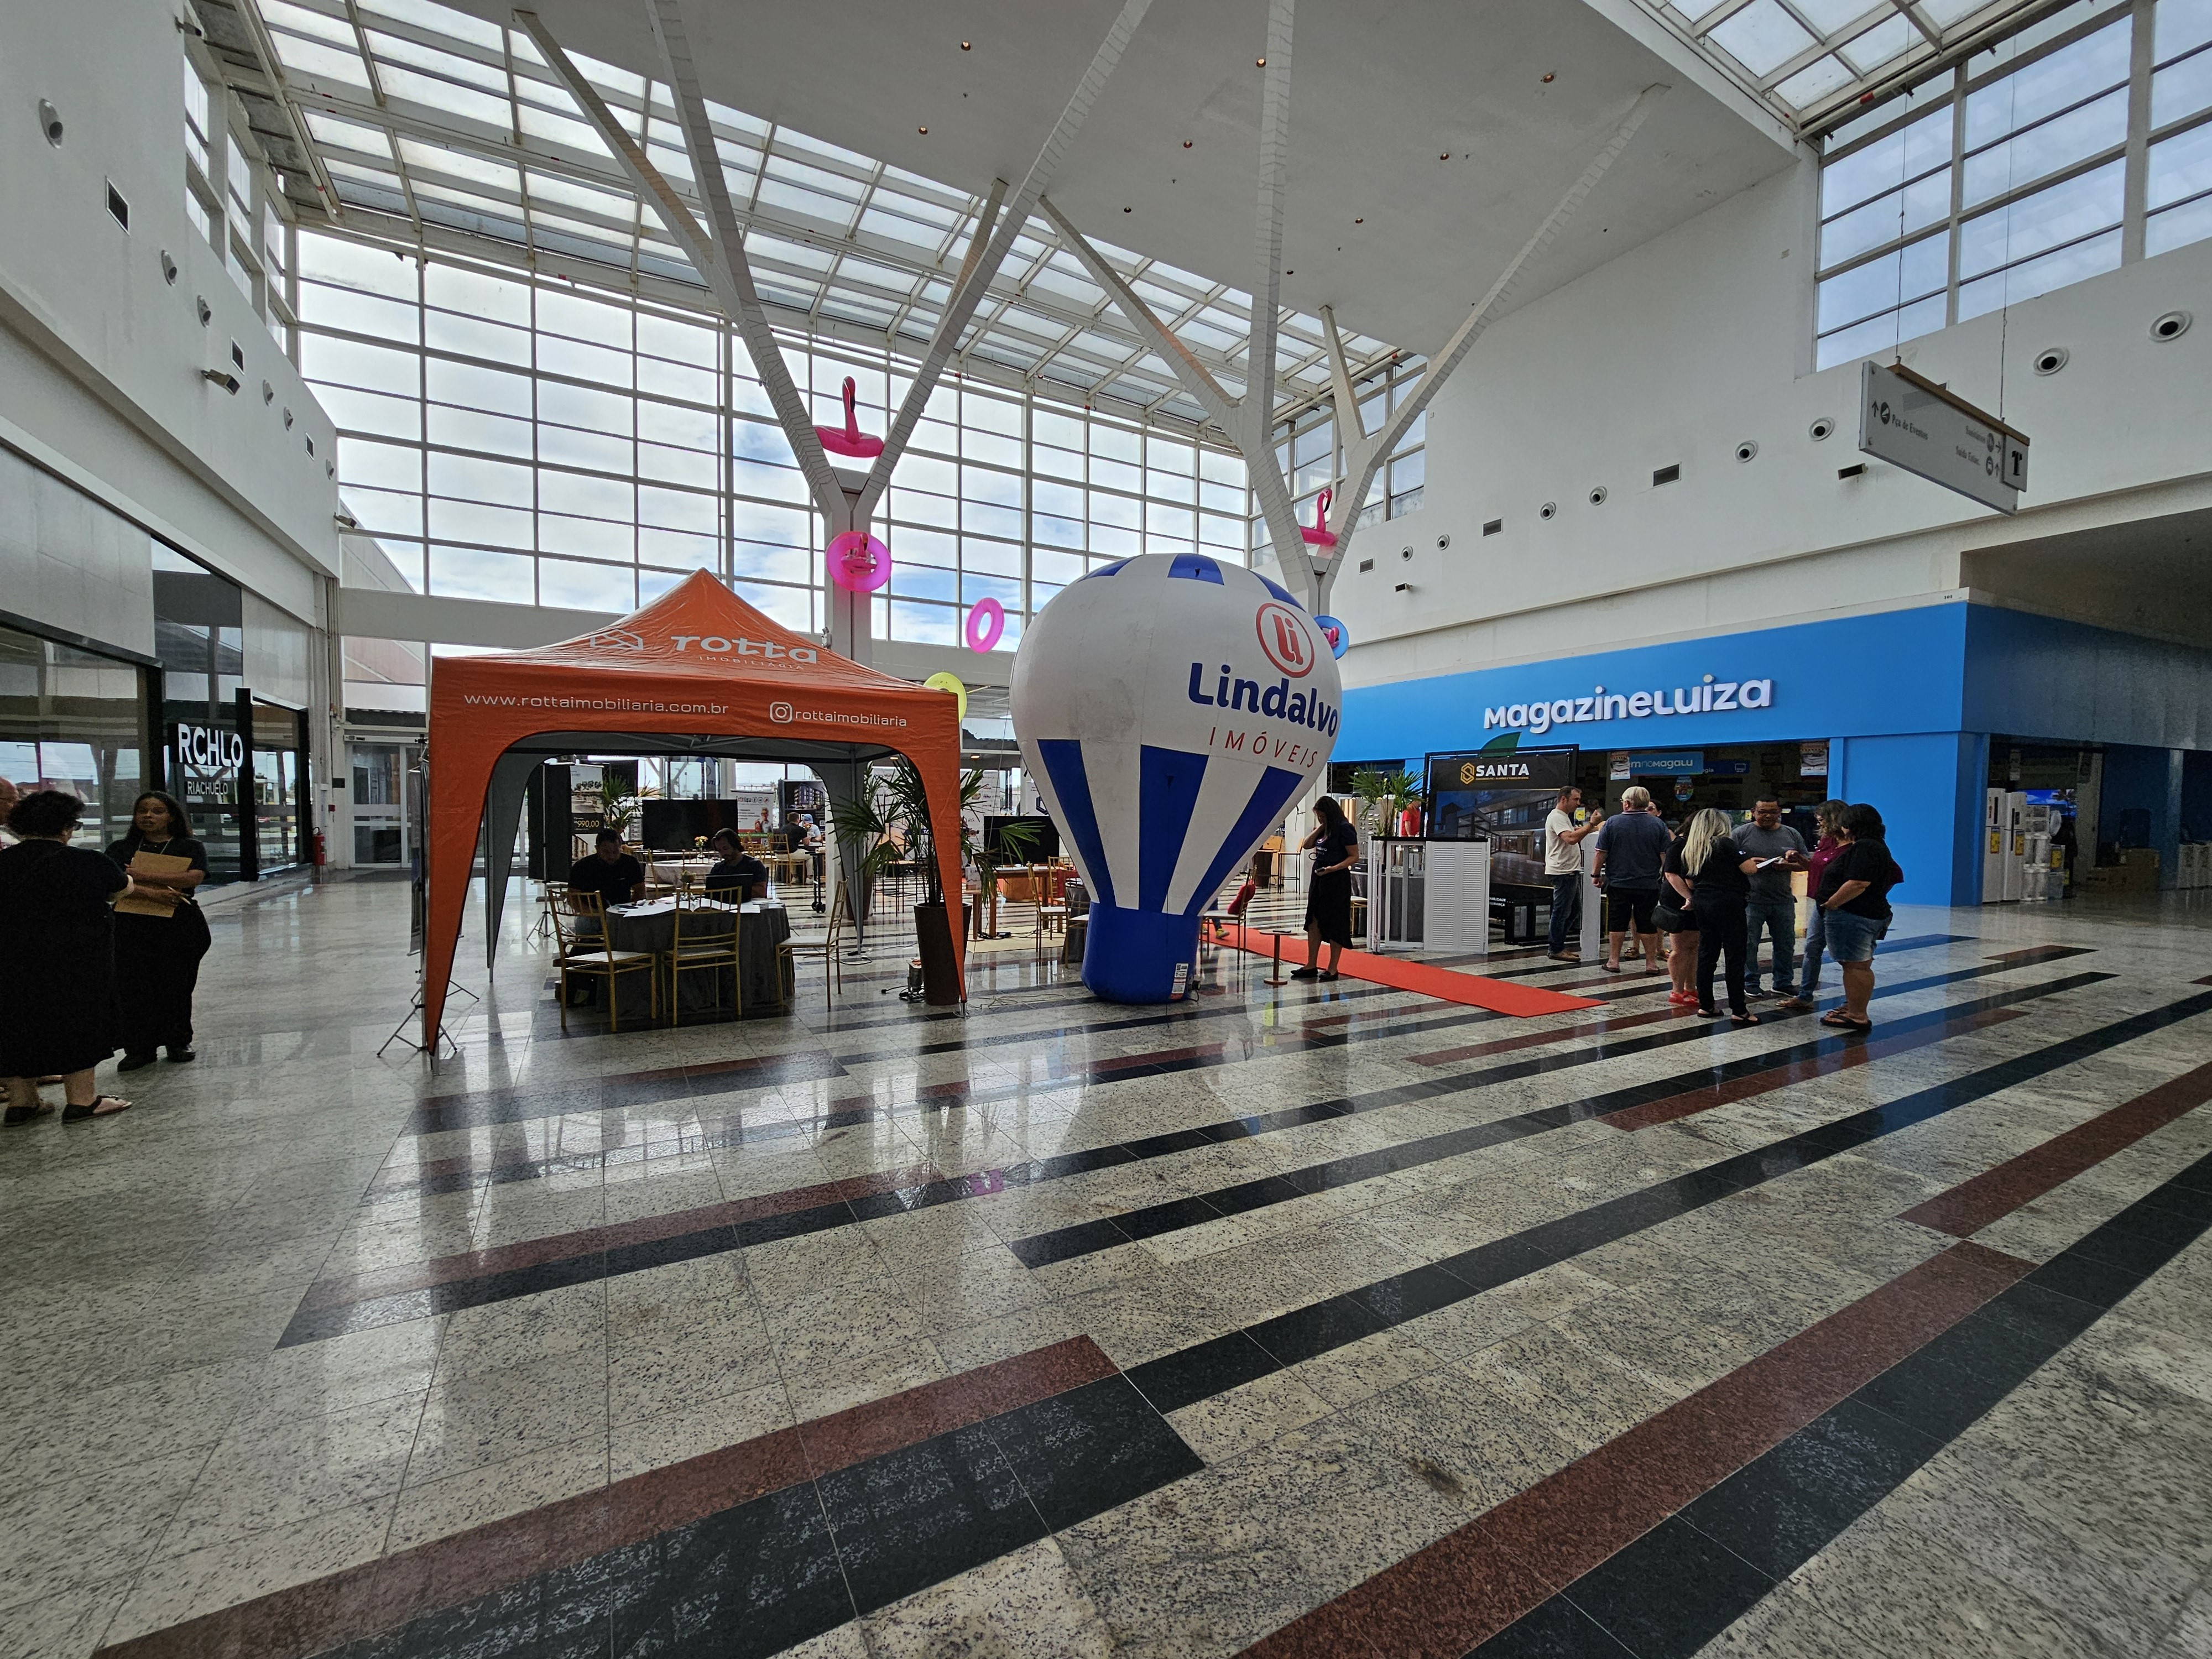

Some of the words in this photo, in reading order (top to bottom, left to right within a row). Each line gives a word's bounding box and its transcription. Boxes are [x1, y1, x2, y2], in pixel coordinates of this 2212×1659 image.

[670, 635, 818, 664] rotta
[464, 694, 729, 714] www.rottaimobiliaria.com.br
[1188, 662, 1338, 737] Lindalvo
[795, 710, 907, 727] rottaimobiliaria
[178, 723, 243, 768] RCHLO
[1209, 727, 1318, 768] IMÓVEIS
[1475, 763, 1530, 777] SANTA
[187, 781, 228, 795] RIACHUELO
